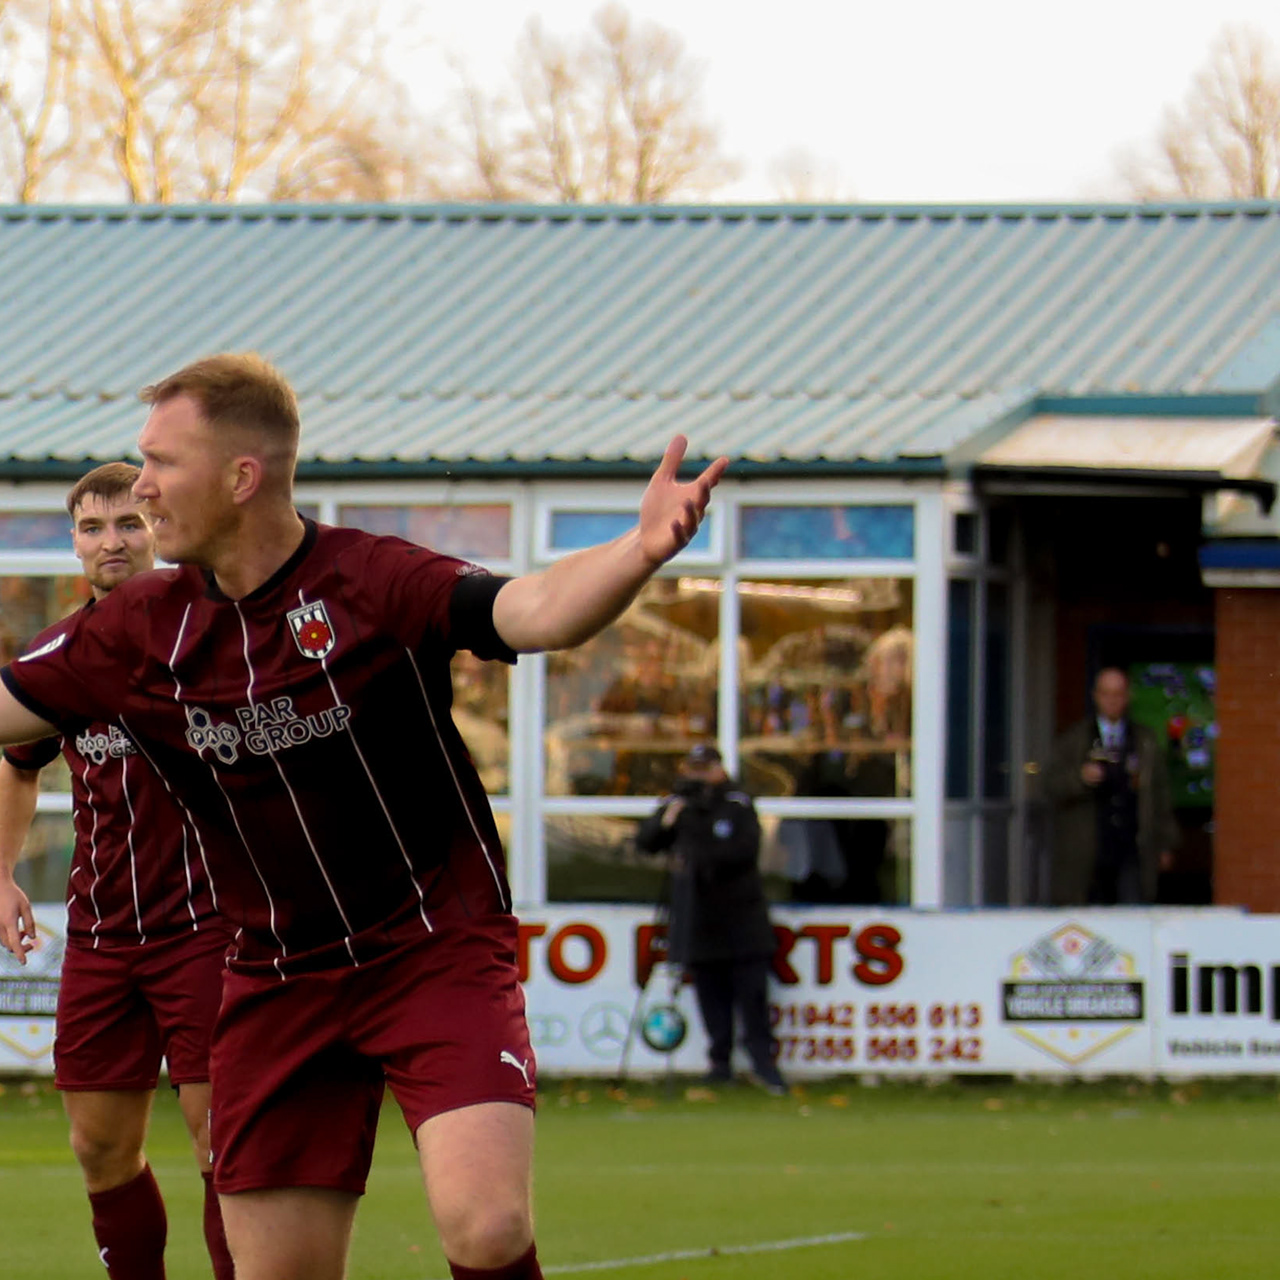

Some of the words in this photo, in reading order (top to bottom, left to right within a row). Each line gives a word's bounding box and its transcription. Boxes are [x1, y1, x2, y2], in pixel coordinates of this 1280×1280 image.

[236, 696, 297, 731] PAR
[245, 704, 352, 755] GROUP
[636, 923, 905, 986] PRTS
